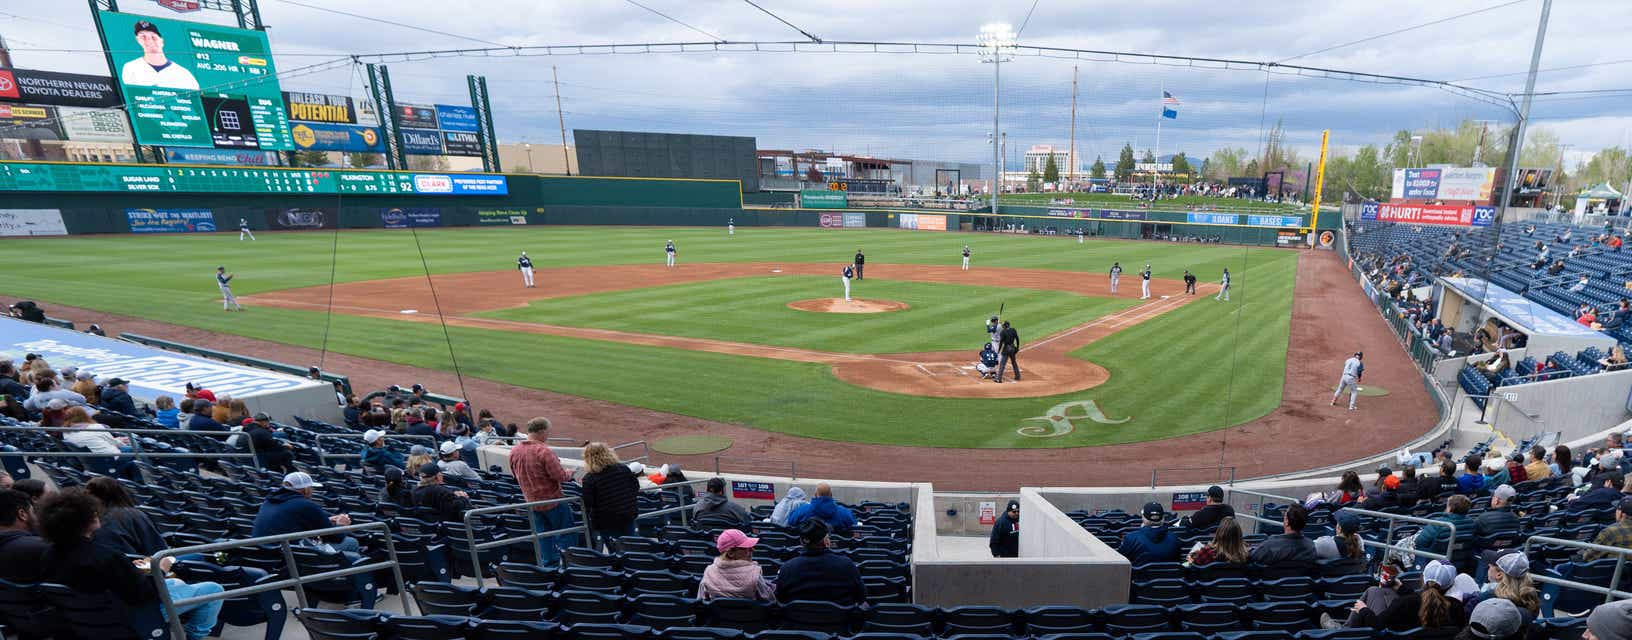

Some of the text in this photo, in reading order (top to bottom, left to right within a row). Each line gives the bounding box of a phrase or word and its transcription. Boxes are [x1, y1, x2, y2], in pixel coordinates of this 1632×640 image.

[191, 37, 240, 51] WAGNER
[197, 62, 211, 70] AVG
[18, 77, 112, 92] NORTHERN NEVADA
[22, 86, 102, 99] TOYOTA DEALERS
[290, 92, 348, 107] UNLEASH YOUR
[402, 132, 440, 146] Dillard's
[455, 134, 478, 143] LITHIA
[236, 154, 264, 164] Chill
[400, 182, 412, 192] 92
[1422, 188, 1436, 196] food
[1362, 204, 1378, 213] roc
[1390, 207, 1422, 220] HURT!
[1474, 207, 1494, 219] roc
[1213, 216, 1234, 224] LOANS
